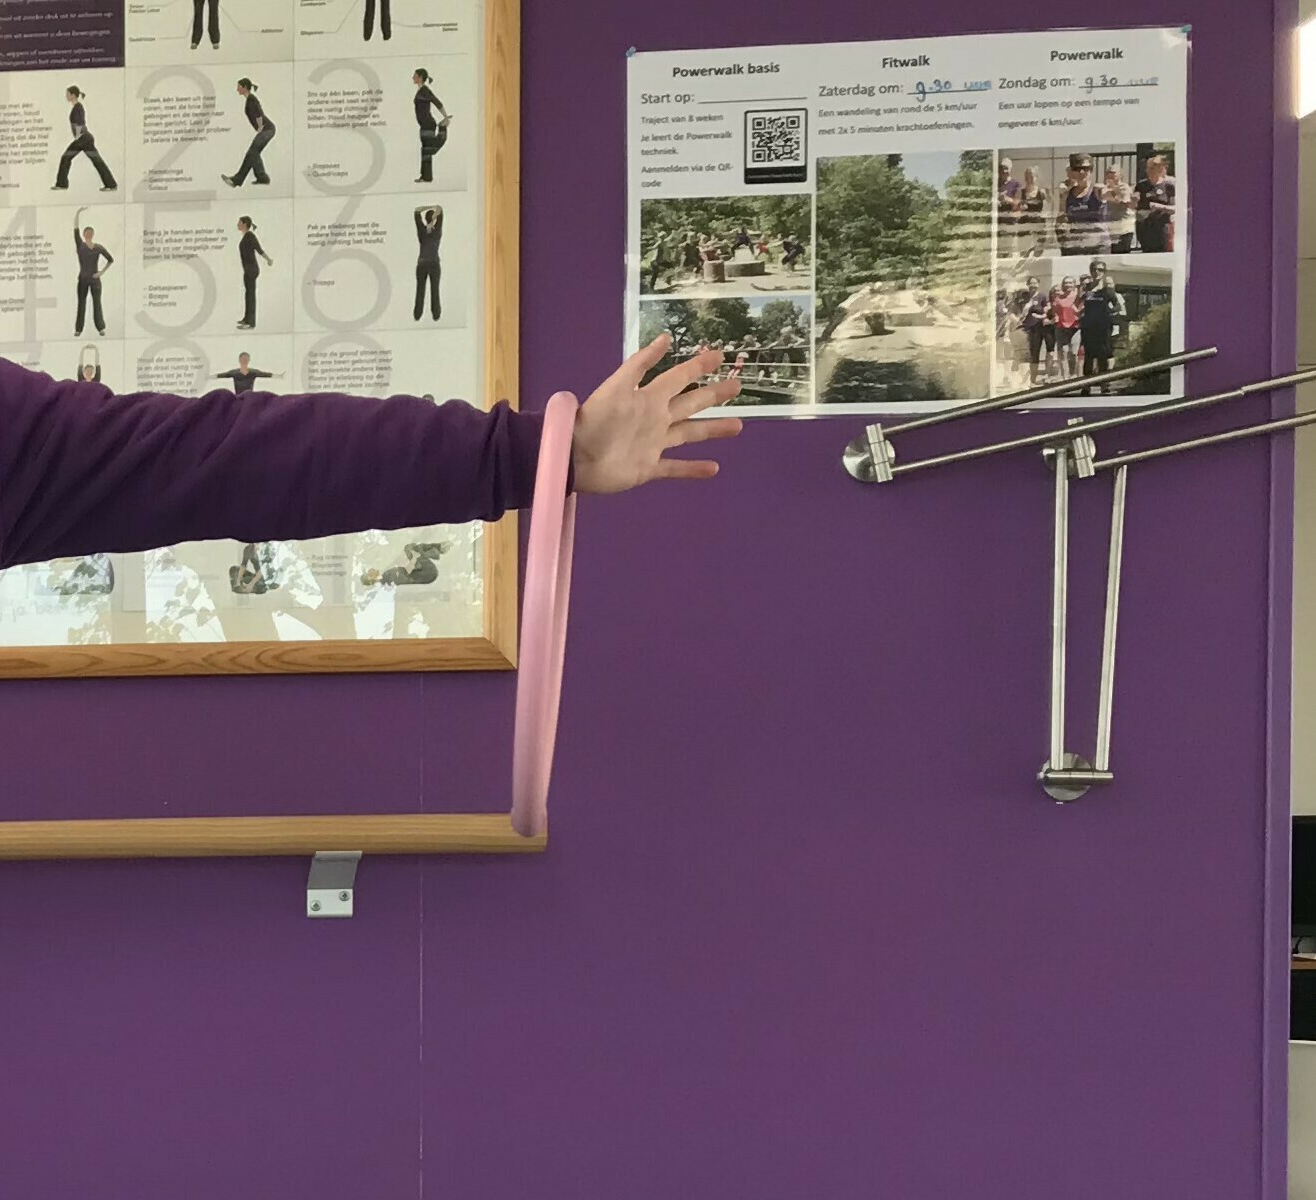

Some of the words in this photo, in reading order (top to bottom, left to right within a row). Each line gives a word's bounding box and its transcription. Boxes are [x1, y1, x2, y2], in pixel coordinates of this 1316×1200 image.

[1050, 48, 1124, 61] Powerwalk
[882, 55, 930, 69] Fitwalk
[672, 64, 744, 78] Powerwalk
[748, 62, 780, 75] basis
[998, 76, 1047, 90] Zondag
[1050, 77, 1076, 88] om:
[818, 83, 876, 97] Zaterdag
[878, 84, 904, 94] om:
[641, 93, 671, 105] Start
[674, 93, 695, 105] op:
[998, 102, 1015, 110] Een
[1034, 100, 1059, 110] lopen
[1061, 101, 1072, 109] op
[1093, 98, 1122, 108] tempo
[818, 109, 835, 117] Een
[836, 107, 881, 117] wandeling
[900, 105, 921, 113] rond
[923, 104, 935, 112] de
[936, 103, 942, 112] 5
[944, 102, 977, 111] km/uur
[641, 116, 669, 125] Traject
[688, 115, 694, 123] 8
[695, 114, 723, 122] weken
[998, 120, 1038, 129] ongeveer
[1040, 118, 1047, 127] 6
[818, 127, 836, 135] met
[837, 126, 848, 135] 2x
[850, 125, 856, 134] 5
[857, 124, 894, 134] minuten
[896, 121, 975, 132] krachtoefeningen.
[651, 133, 672, 142] leert
[673, 133, 685, 141] de
[686, 131, 733, 141] Powerwalk
[641, 147, 679, 156] techniek.
[641, 165, 689, 174] Aanmelden
[691, 163, 703, 172] via
[704, 163, 716, 172] de
[641, 180, 662, 188] code
